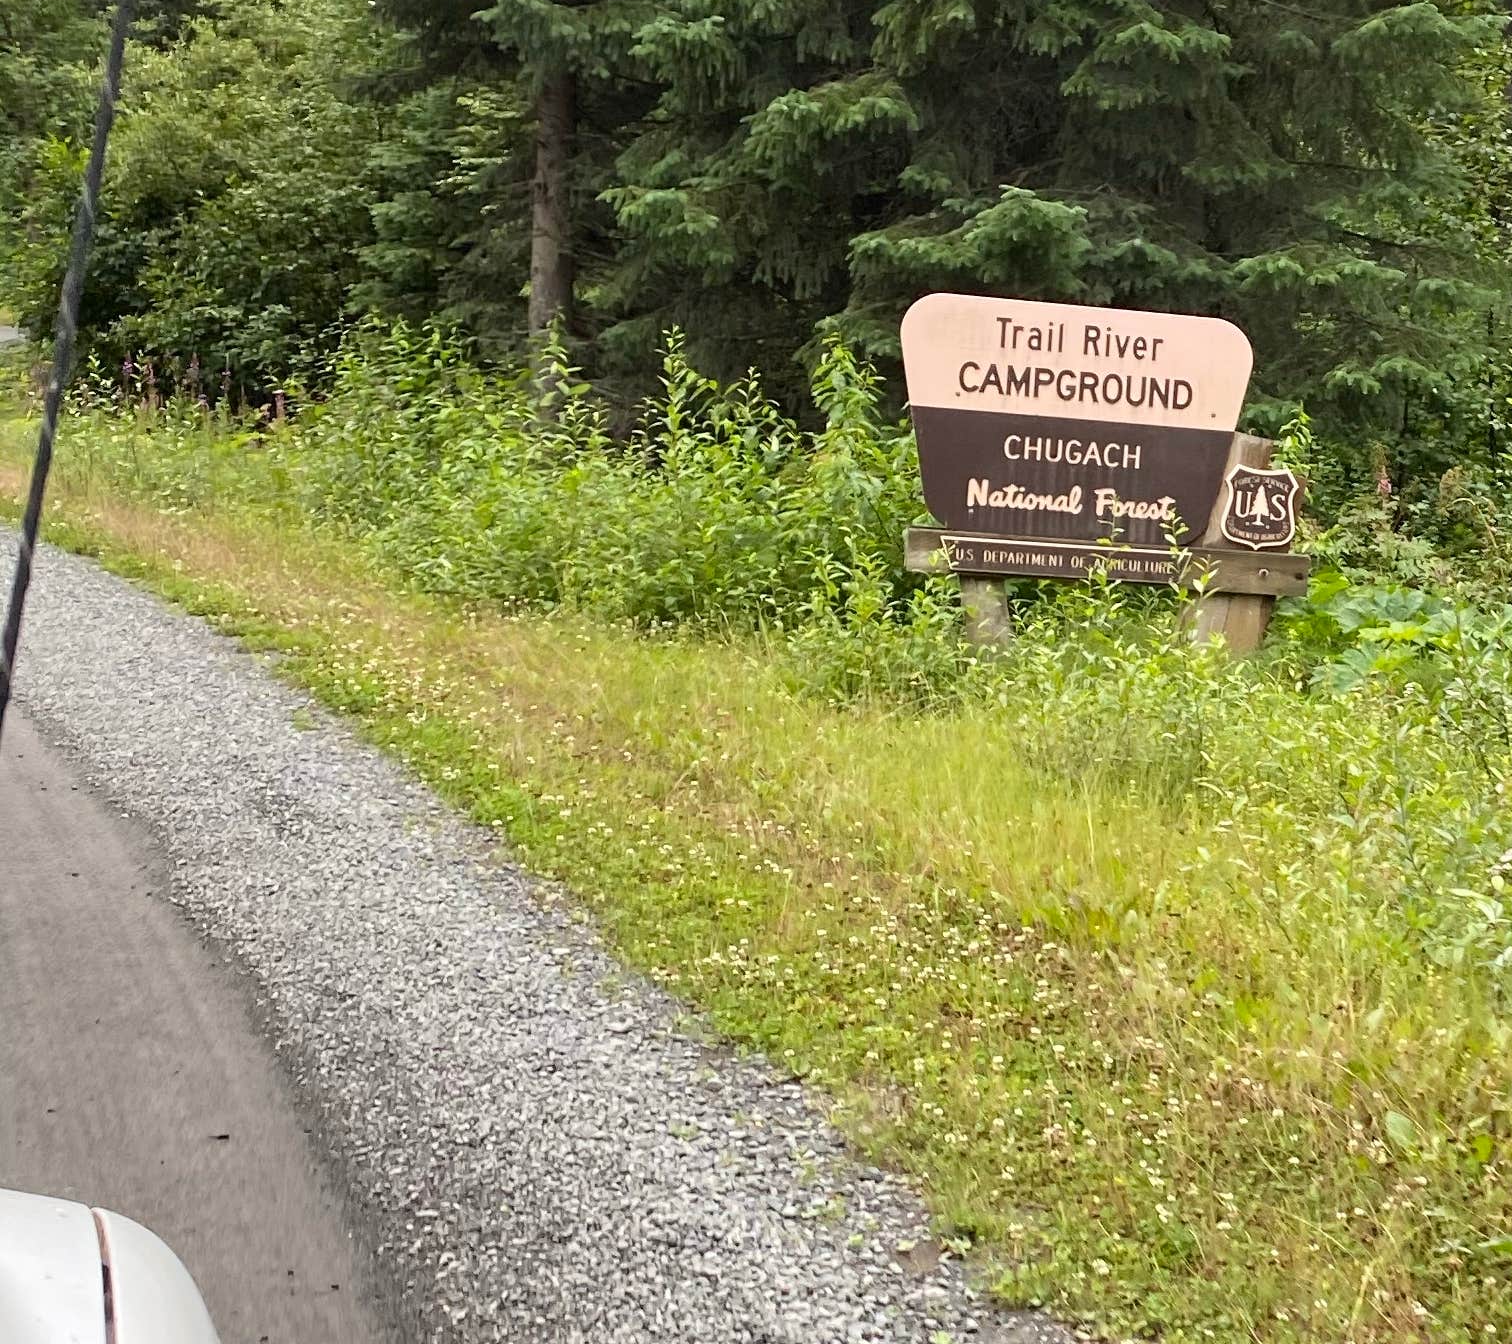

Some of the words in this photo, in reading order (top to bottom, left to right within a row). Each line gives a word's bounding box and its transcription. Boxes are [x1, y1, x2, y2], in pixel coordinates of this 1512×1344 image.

[996, 316, 1065, 353] Trail
[1083, 324, 1164, 361] River
[958, 361, 1194, 411] CAMPGROUND
[1003, 434, 1142, 470] CHUGACH
[966, 477, 1084, 515] National
[1093, 487, 1177, 521] Forest
[983, 549, 1064, 568] DEPARTMENT
[1070, 555, 1087, 570] OF
